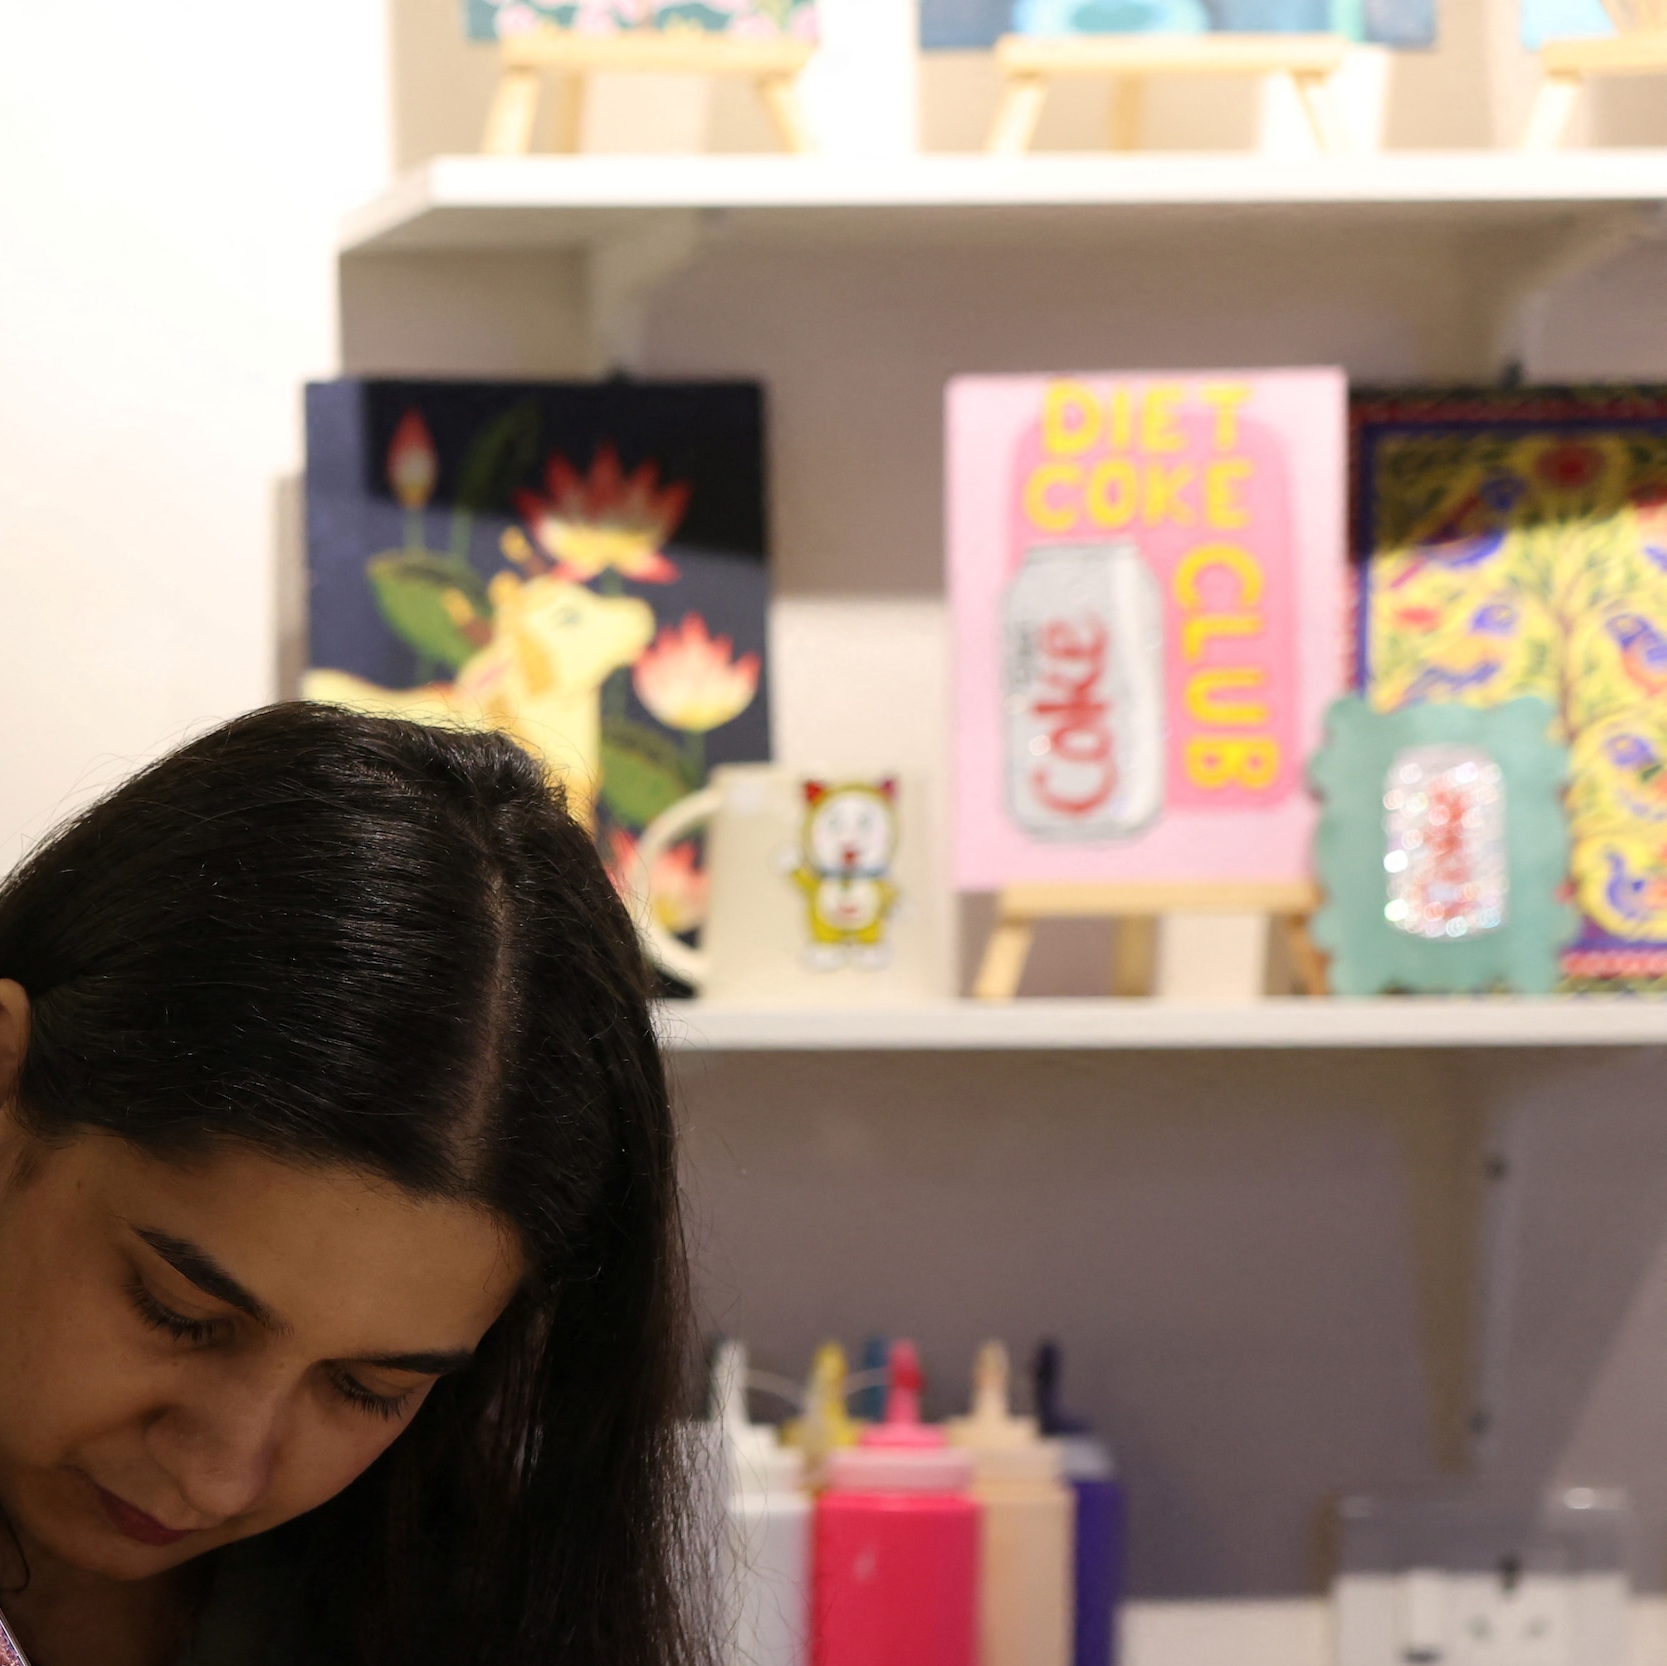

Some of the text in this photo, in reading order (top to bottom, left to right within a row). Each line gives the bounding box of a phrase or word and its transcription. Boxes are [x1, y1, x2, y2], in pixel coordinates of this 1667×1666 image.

[1044, 381, 1251, 455] DIET
[1025, 459, 1252, 529] COKE
[1031, 613, 1118, 817] Coke
[1176, 546, 1279, 790] CLUB
